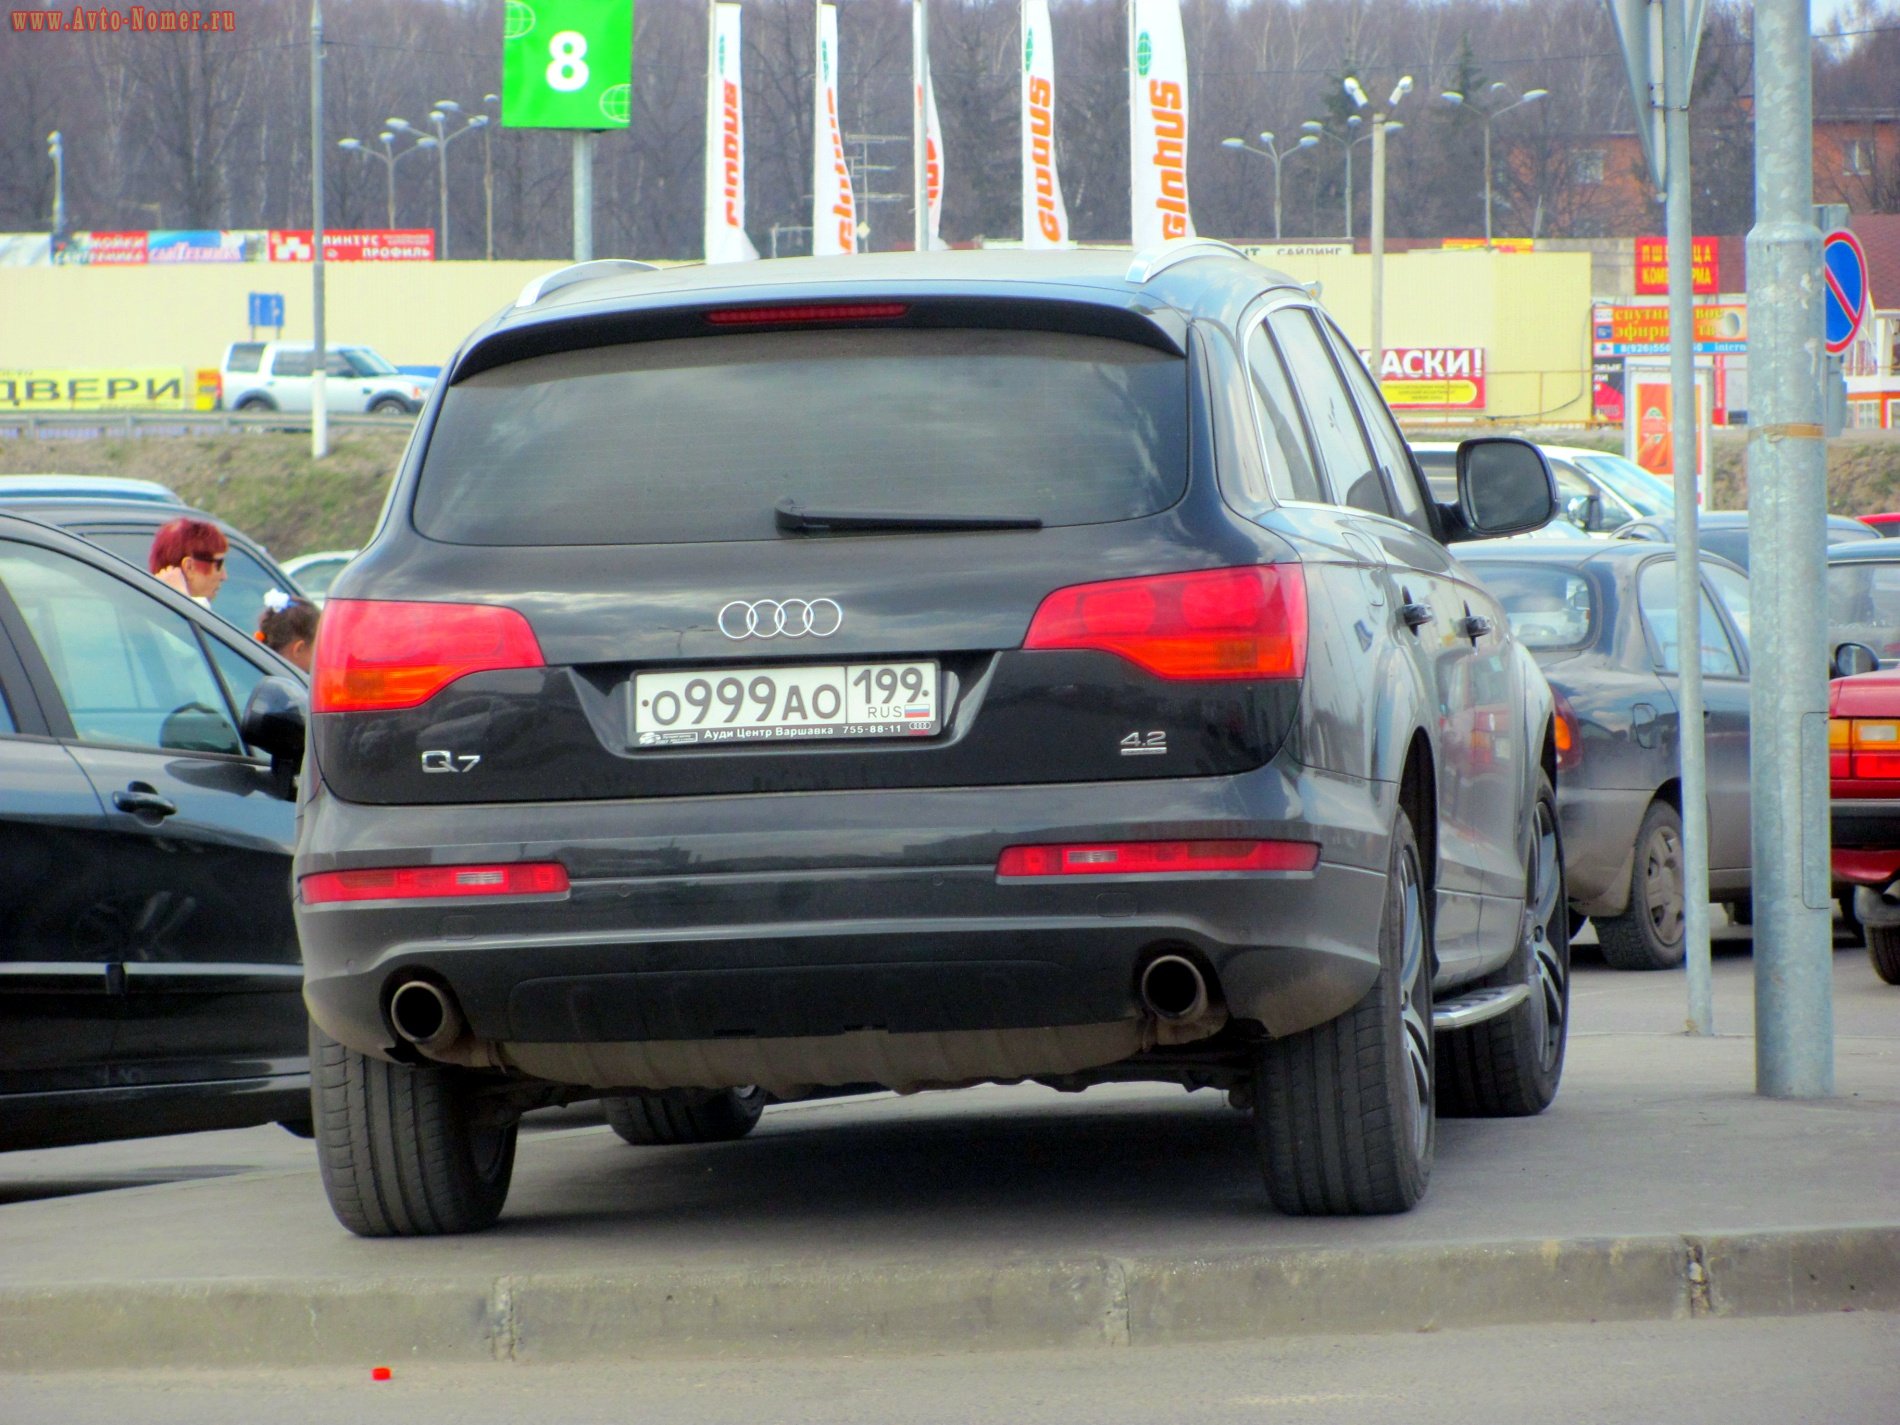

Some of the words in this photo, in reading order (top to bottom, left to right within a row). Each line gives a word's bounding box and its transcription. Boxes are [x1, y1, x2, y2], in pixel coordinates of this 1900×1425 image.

[545, 30, 590, 92] 8
[312, 234, 379, 246] ЛИНТУС
[362, 247, 430, 258] ПРОФИЛЬ
[651, 676, 842, 726] О999АО
[853, 667, 924, 704] 199
[867, 705, 902, 719] RUS
[703, 729, 734, 741] Ауди
[736, 728, 772, 740] Центр
[775, 726, 834, 738] Варшавка
[842, 725, 901, 734] 755-88-11
[1120, 731, 1167, 746] 4.2
[421, 750, 481, 773] Q7
